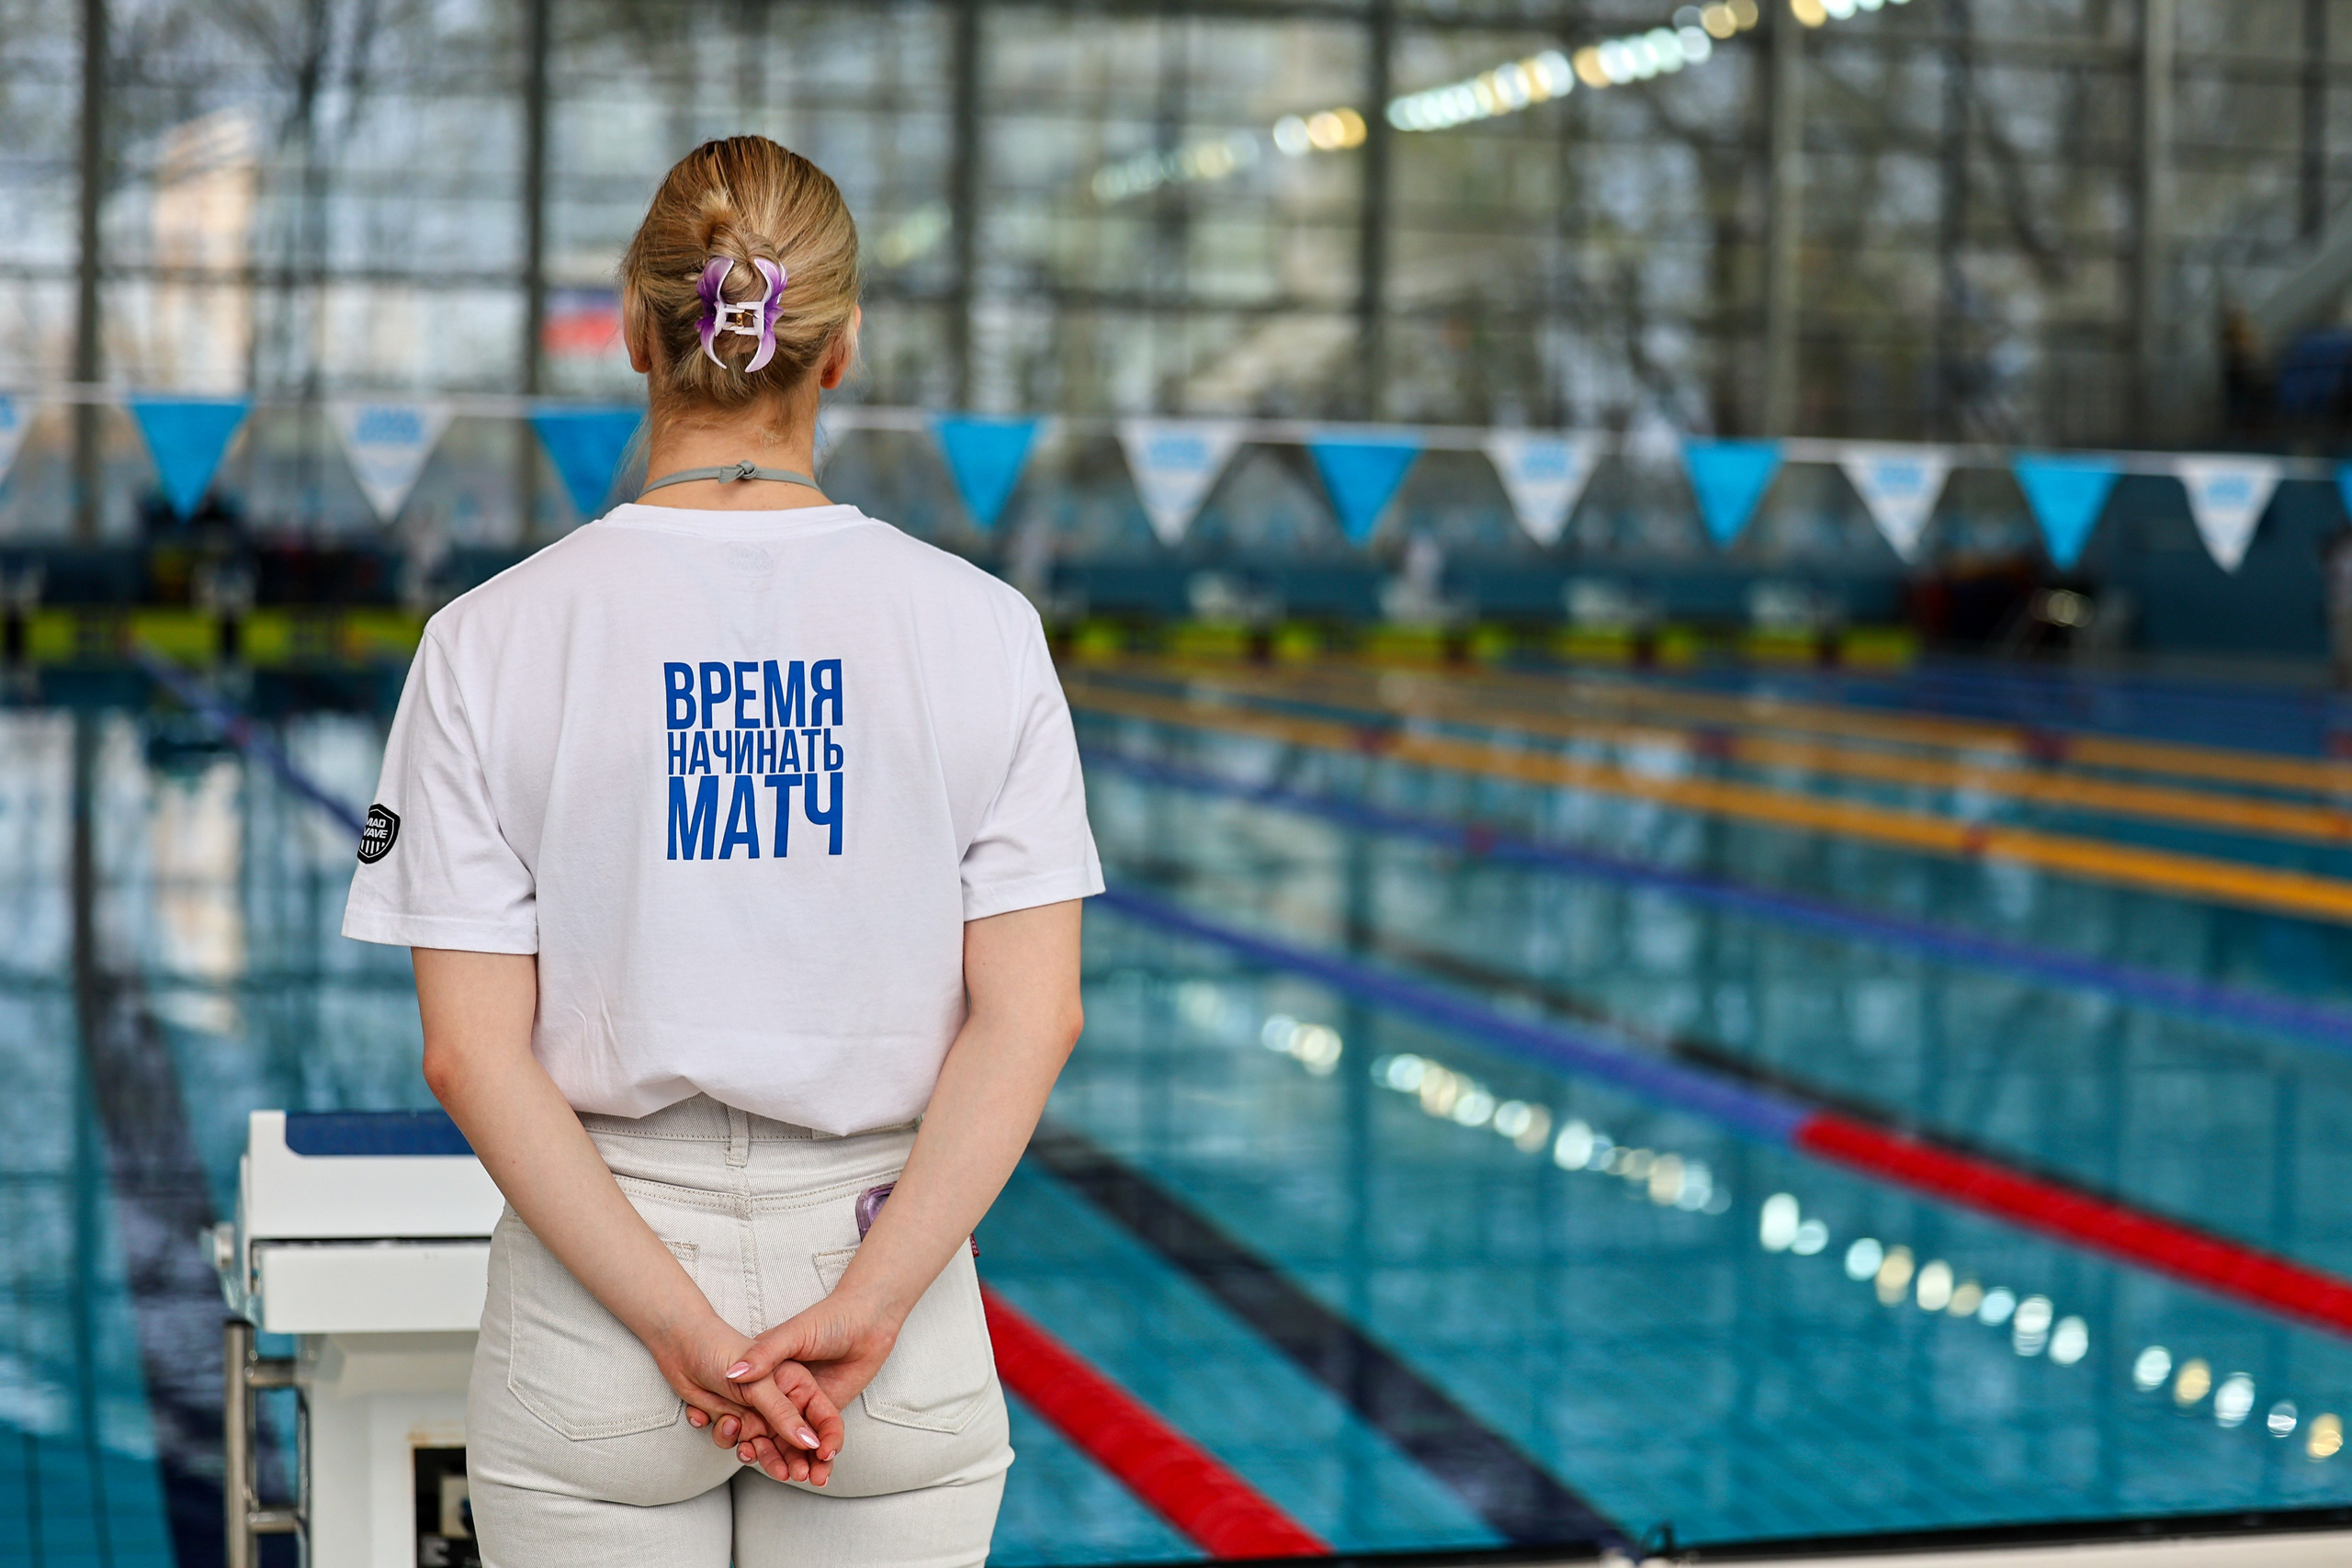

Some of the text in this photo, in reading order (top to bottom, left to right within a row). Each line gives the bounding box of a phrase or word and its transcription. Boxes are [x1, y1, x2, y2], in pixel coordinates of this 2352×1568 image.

[663, 659, 843, 730] ВРЕМЯ
[667, 728, 844, 775] НАЧИНАТЬ
[667, 772, 843, 861] МАТЧ
